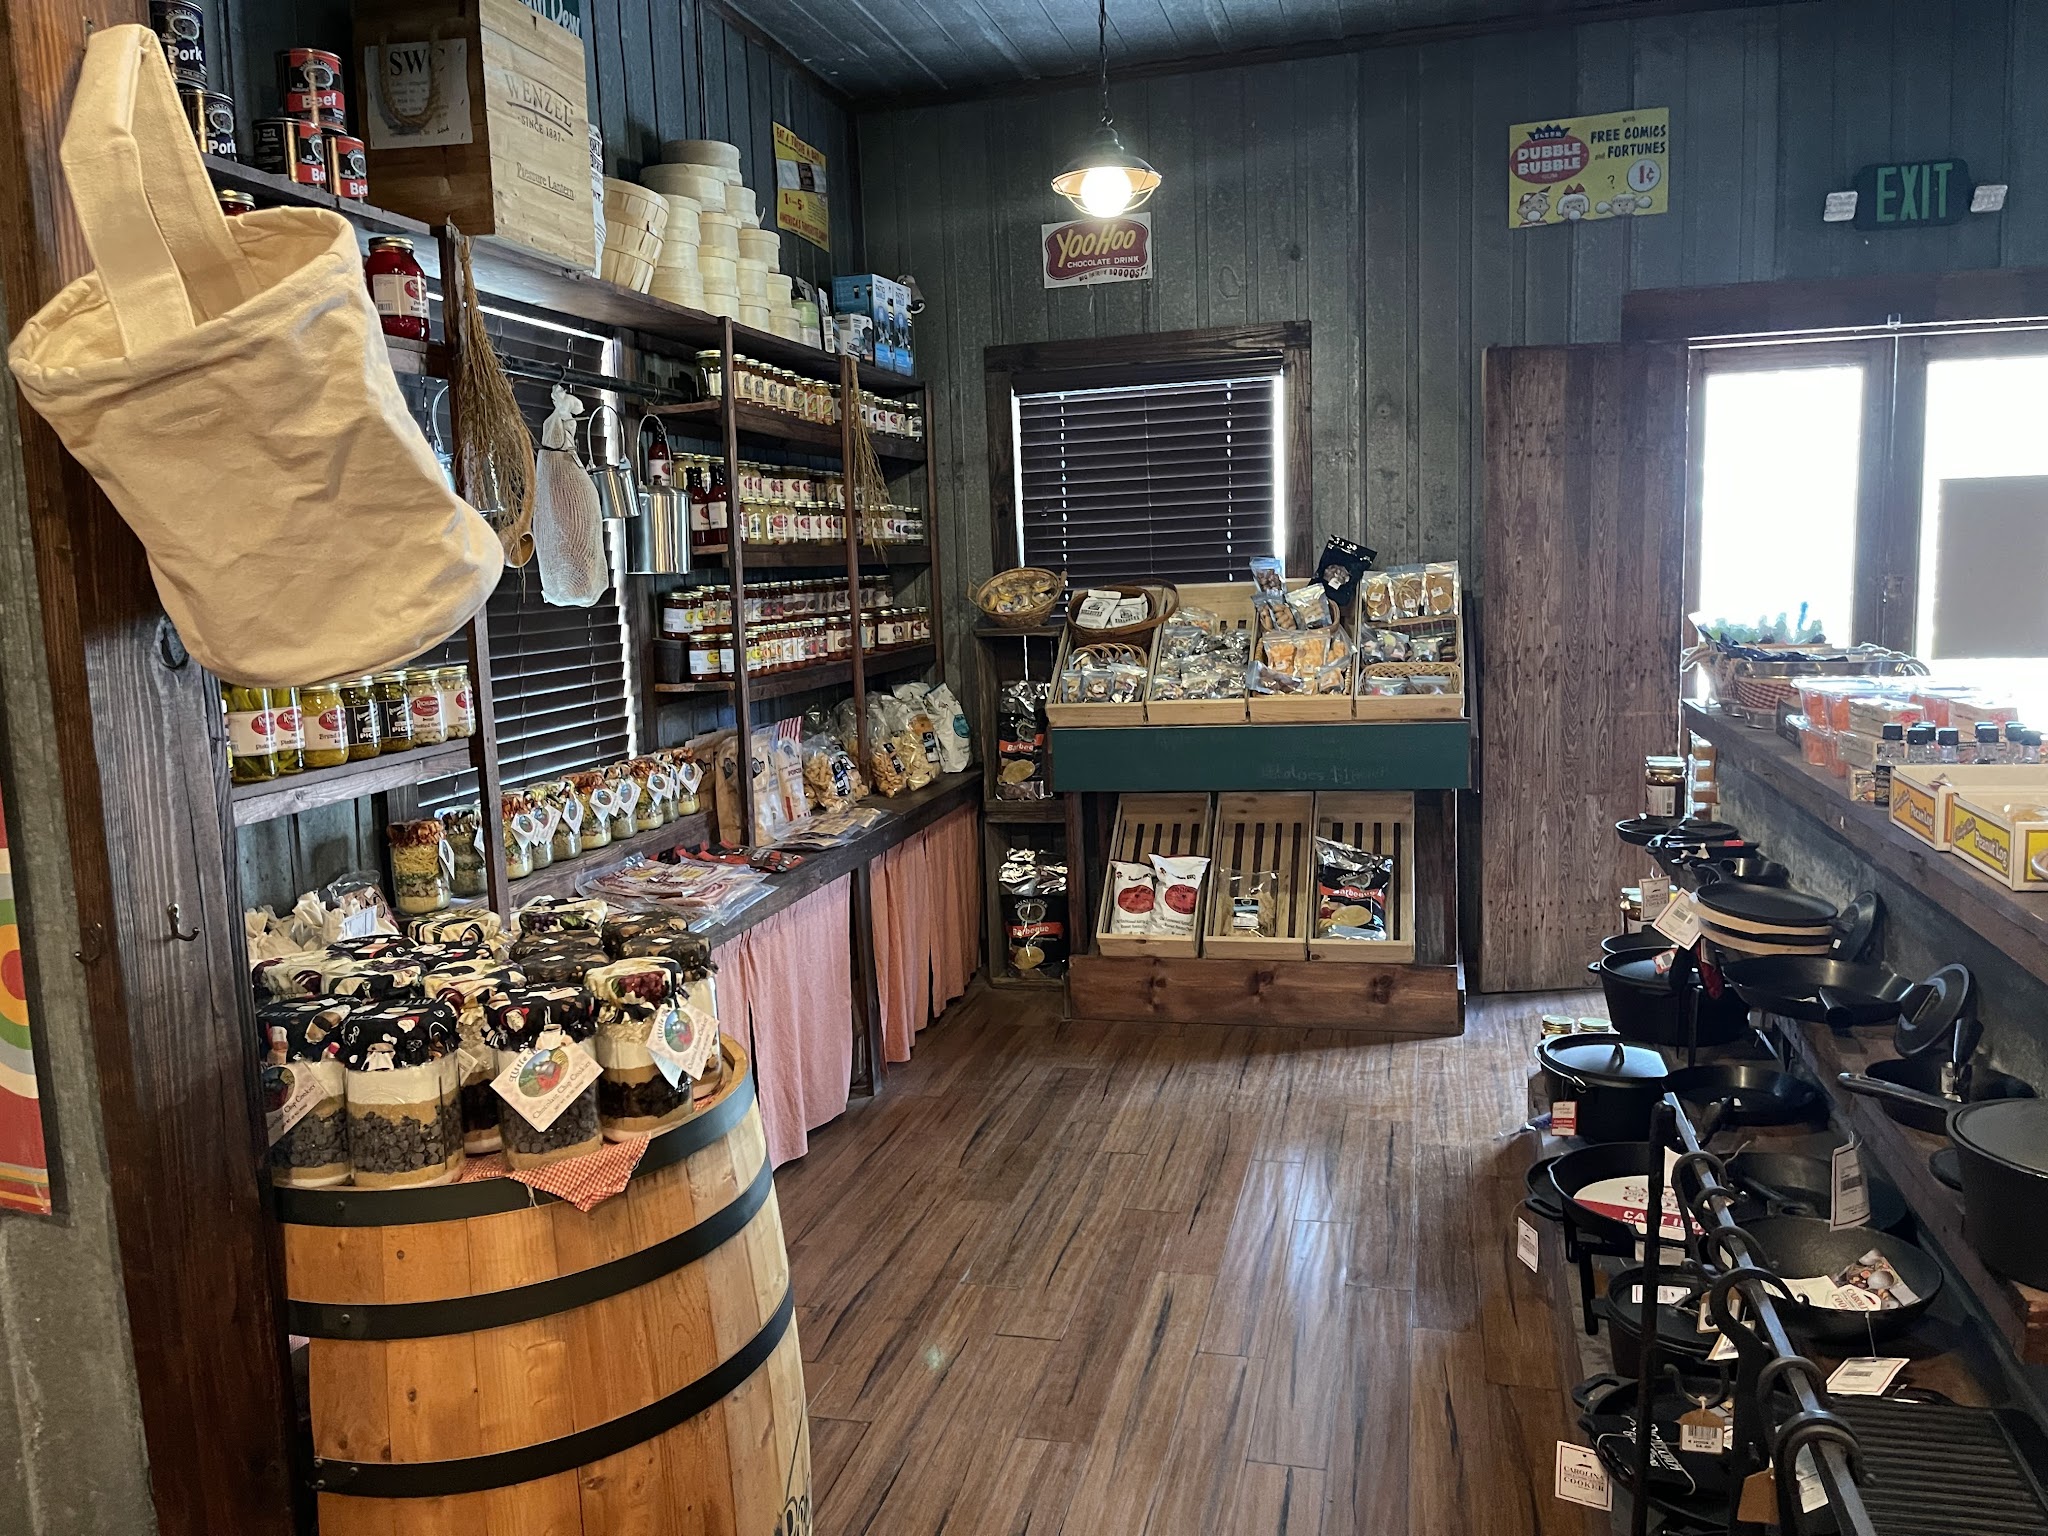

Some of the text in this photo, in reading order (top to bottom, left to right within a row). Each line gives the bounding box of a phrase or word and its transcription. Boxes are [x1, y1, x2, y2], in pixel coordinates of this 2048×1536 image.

[167, 45, 203, 63] Pork
[301, 93, 337, 109] Beef
[504, 73, 573, 129] WENZEL
[1590, 124, 1666, 144] FREE COMICS
[1517, 142, 1581, 161] DUBBLE
[1608, 141, 1666, 159] FORTUNES
[1518, 156, 1581, 175] BUBBLE
[547, 175, 574, 198] Lantern
[1877, 162, 1953, 222] EXIT
[1067, 255, 1139, 269] CHOCOLATE DRINK
[1012, 926, 1050, 937] Barbeque
[295, 1084, 316, 1103] Cookies
[532, 1093, 560, 1120] Chocolate
[556, 1080, 572, 1094] Chip
[1563, 1465, 1605, 1482] CAROLINA
[1563, 1476, 1604, 1492] COOKER
